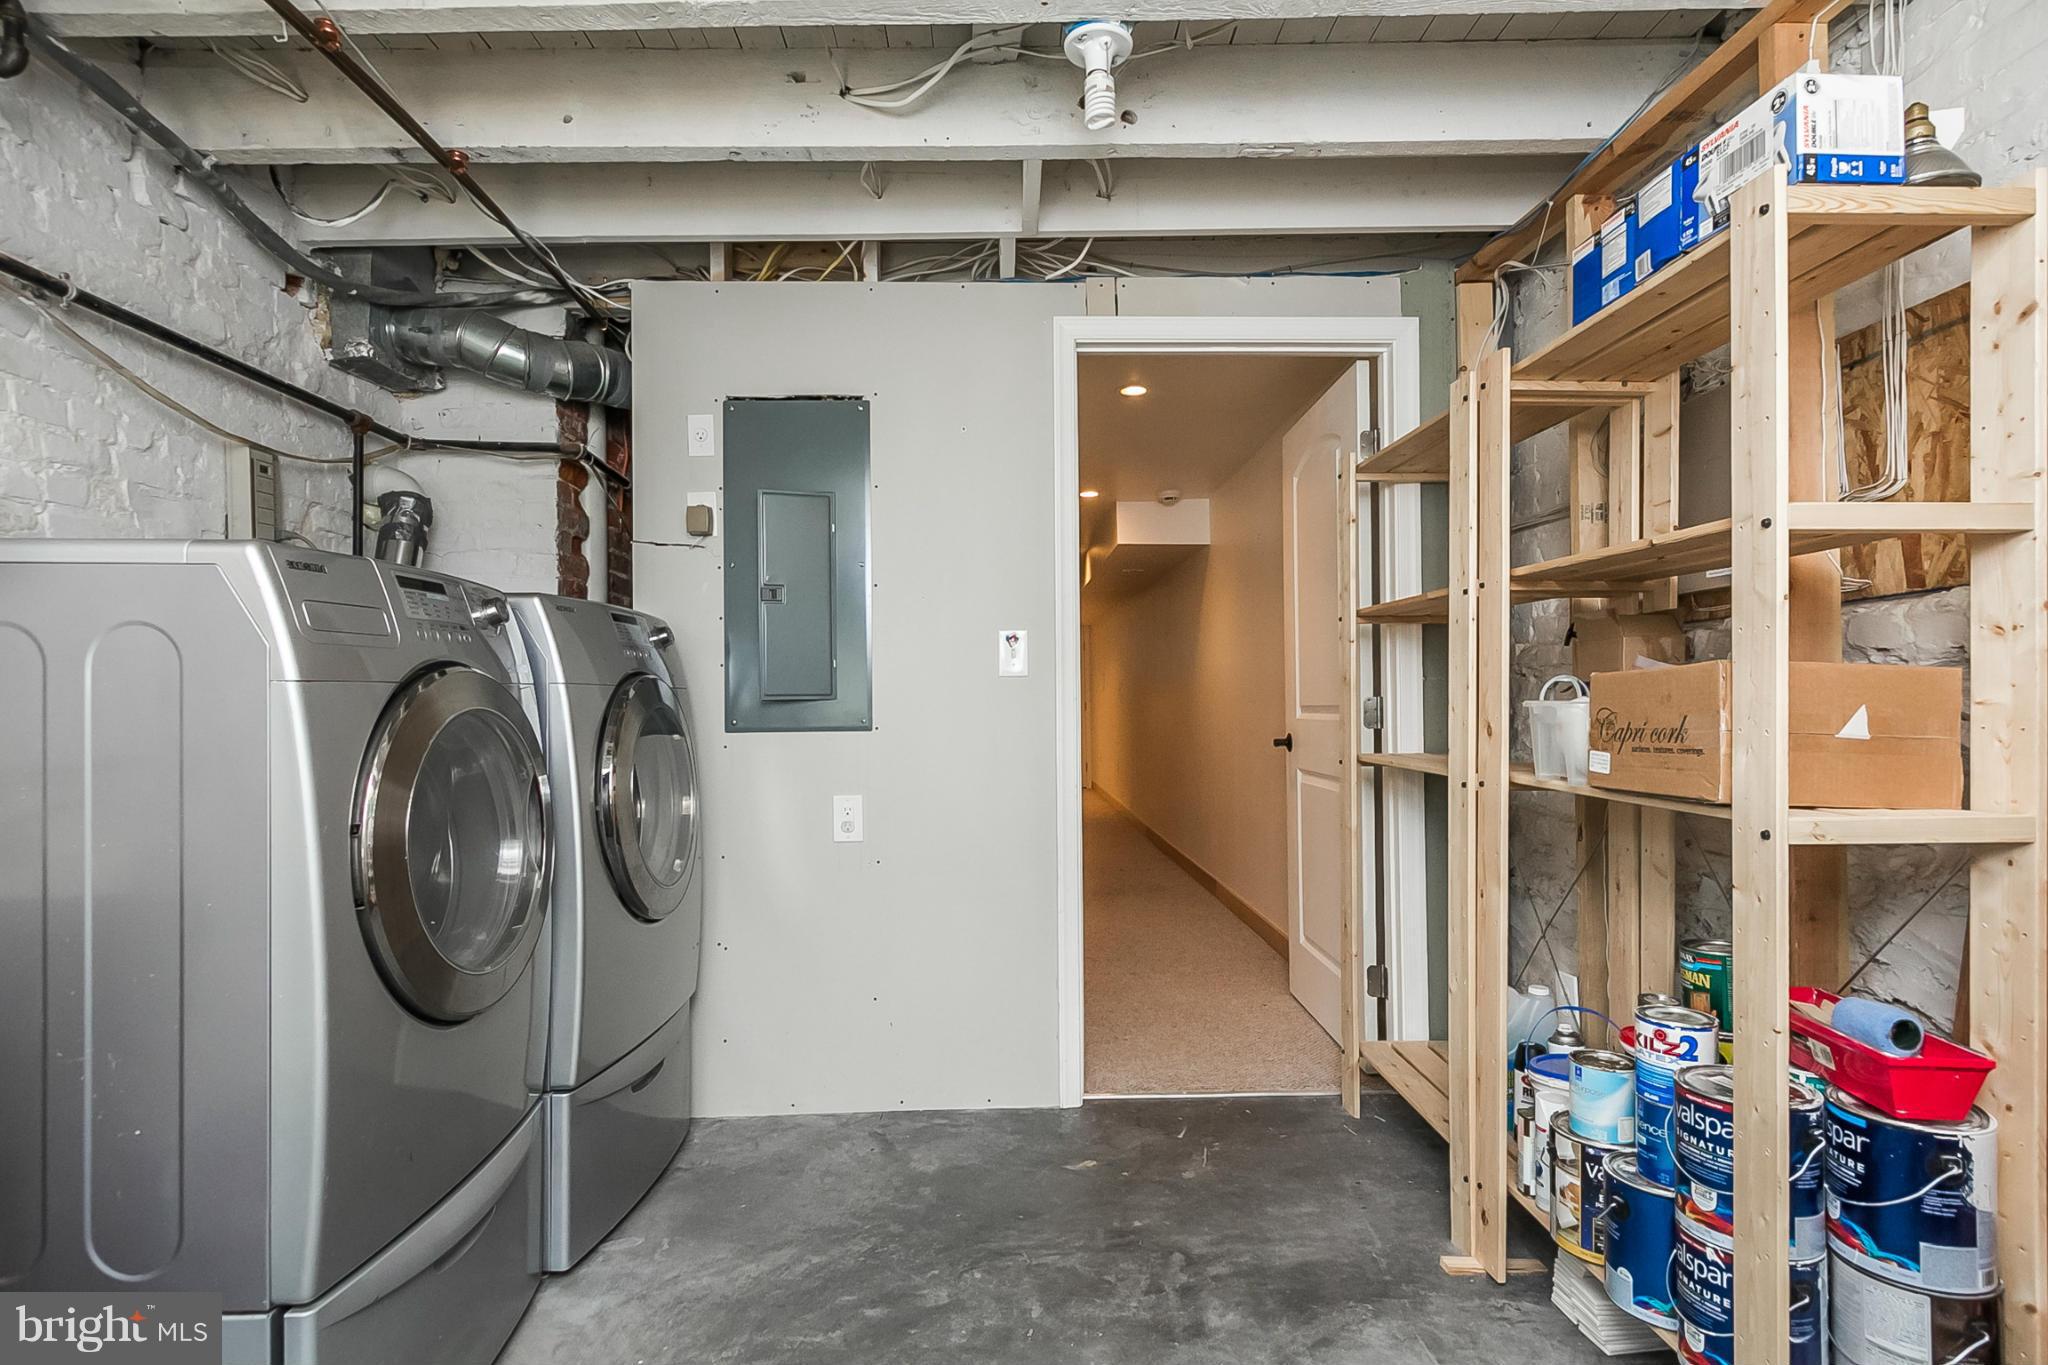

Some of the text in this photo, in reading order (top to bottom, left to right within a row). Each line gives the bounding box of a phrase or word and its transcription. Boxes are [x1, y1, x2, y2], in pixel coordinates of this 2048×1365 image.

[1701, 121, 1739, 152] SYLVANIA
[1596, 707, 1689, 755] Capri cork
[1680, 1035, 1698, 1062] 2
